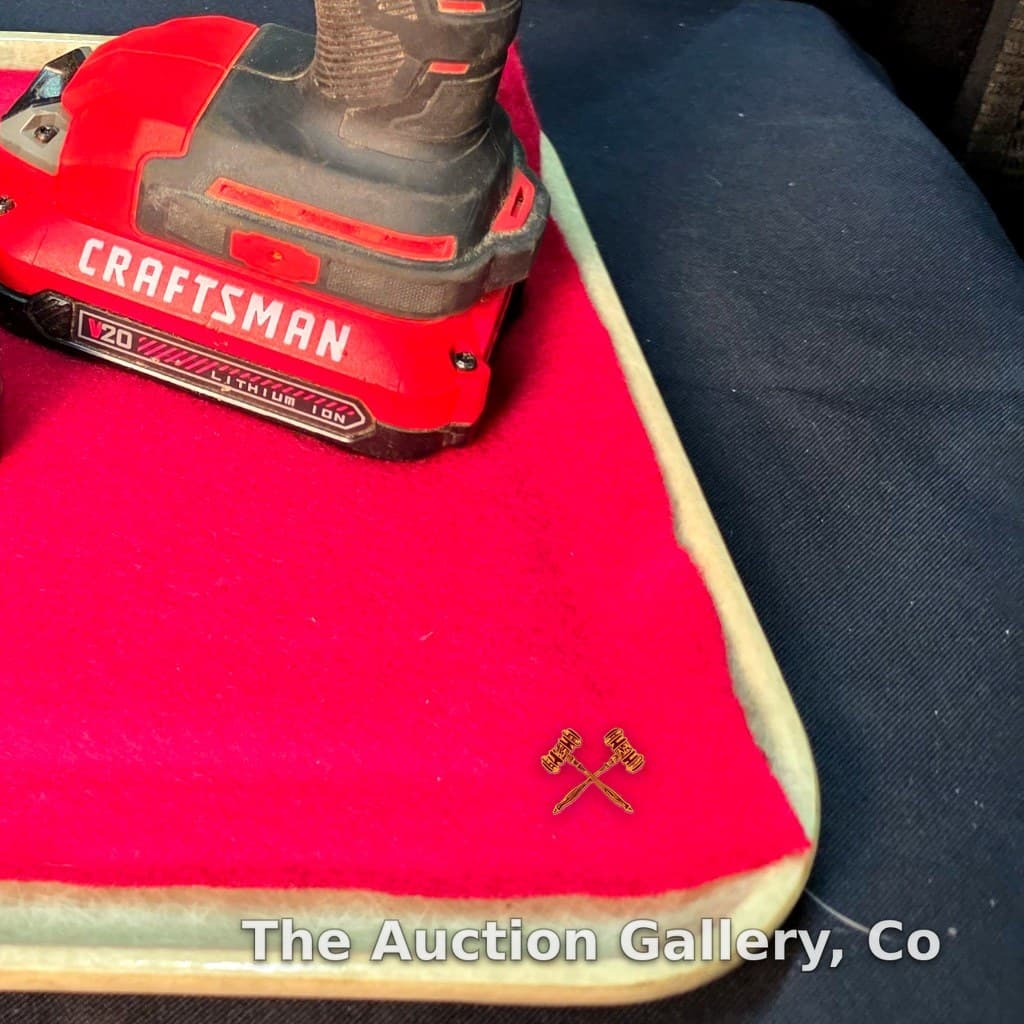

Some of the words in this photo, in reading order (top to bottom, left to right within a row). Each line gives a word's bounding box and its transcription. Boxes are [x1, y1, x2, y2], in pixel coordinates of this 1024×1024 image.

[78, 238, 352, 363] CRAFTSMAN
[88, 317, 133, 350] V20
[211, 369, 296, 408] LITHIUM
[312, 404, 347, 425] ION
